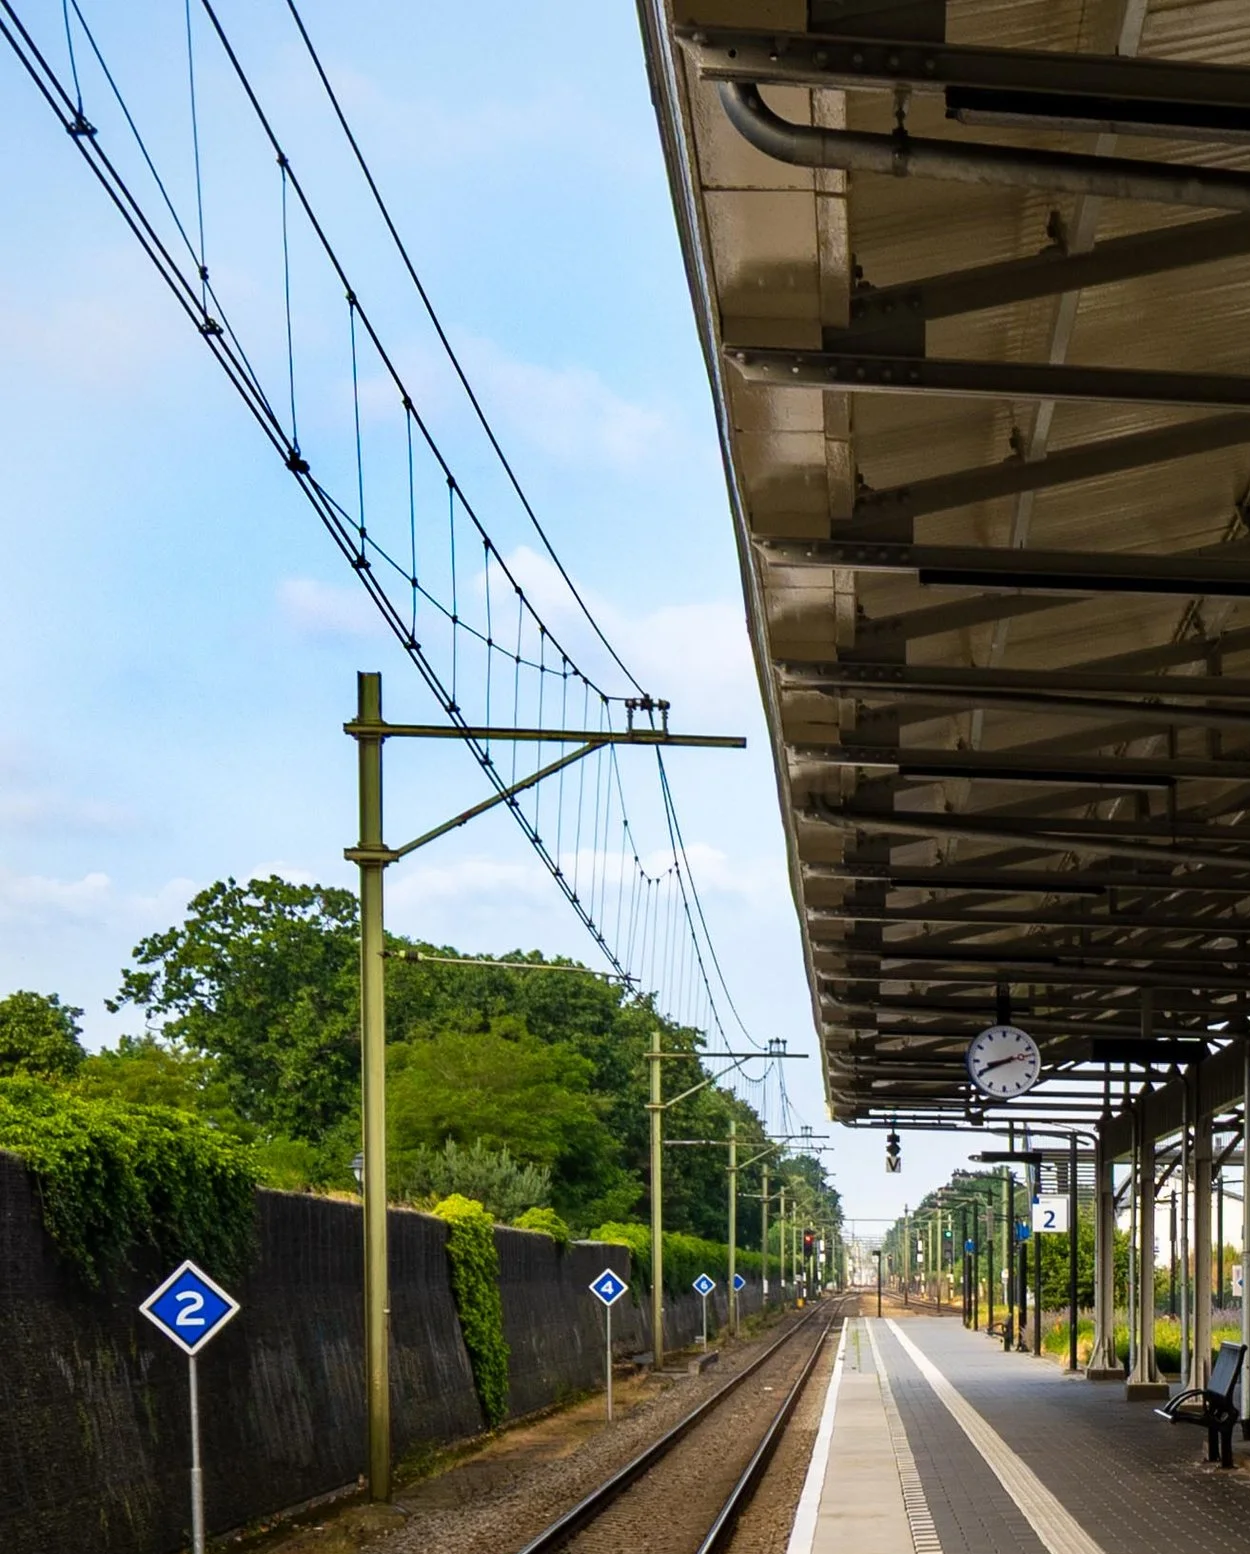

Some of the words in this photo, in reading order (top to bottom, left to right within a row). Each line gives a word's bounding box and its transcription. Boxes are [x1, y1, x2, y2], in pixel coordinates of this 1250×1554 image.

[1043, 1210, 1056, 1228] 2
[600, 1281, 614, 1295] 4
[700, 1280, 708, 1290] 6
[175, 1290, 205, 1326] 2
